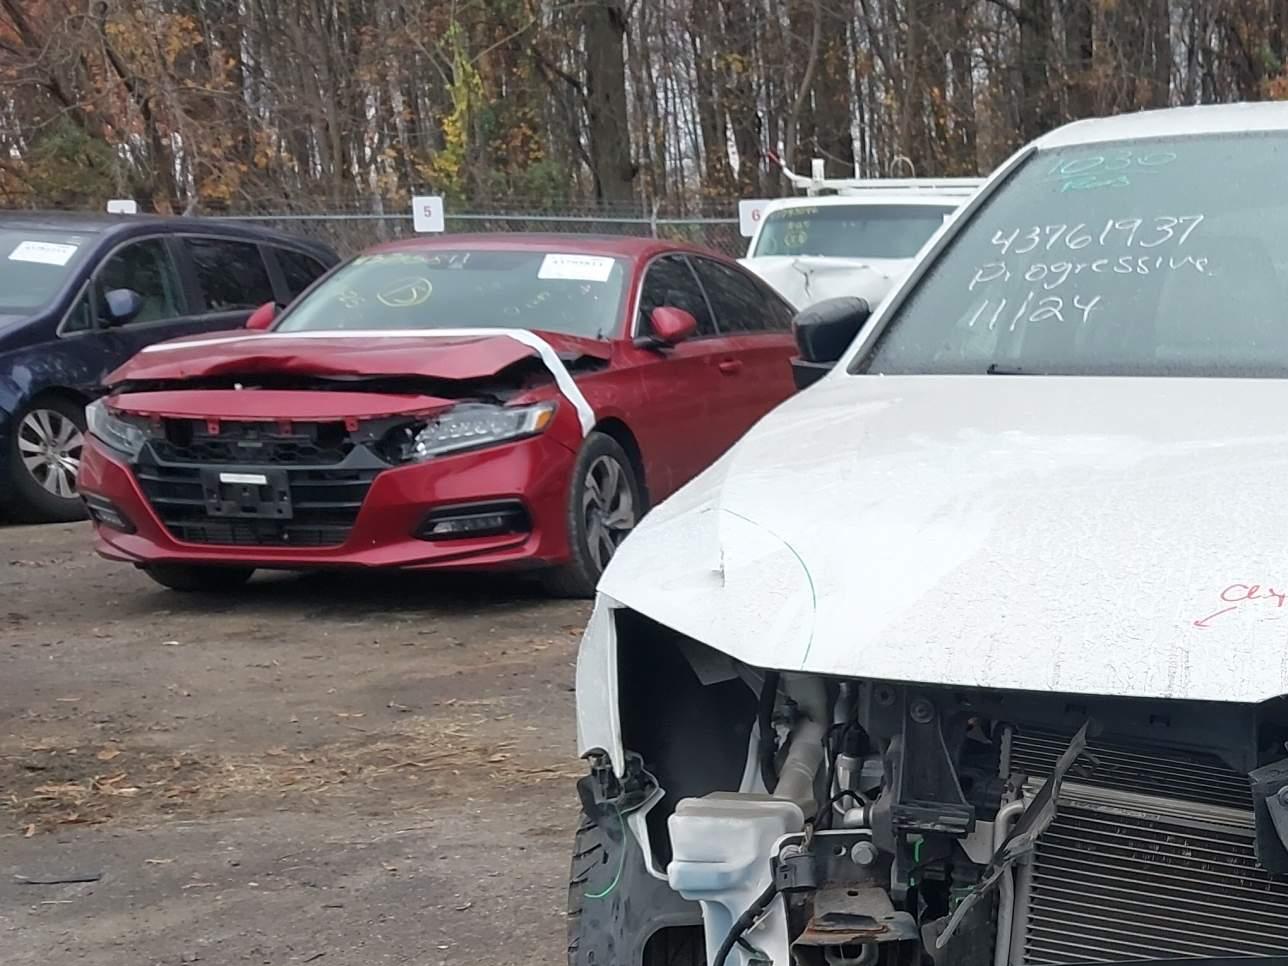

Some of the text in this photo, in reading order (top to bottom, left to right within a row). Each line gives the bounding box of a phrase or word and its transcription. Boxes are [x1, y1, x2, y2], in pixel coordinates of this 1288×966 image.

[423, 205, 432, 218] 5
[751, 208, 761, 221] 6
[991, 214, 1205, 255] 43761937
[968, 291, 1101, 332] 11/24
